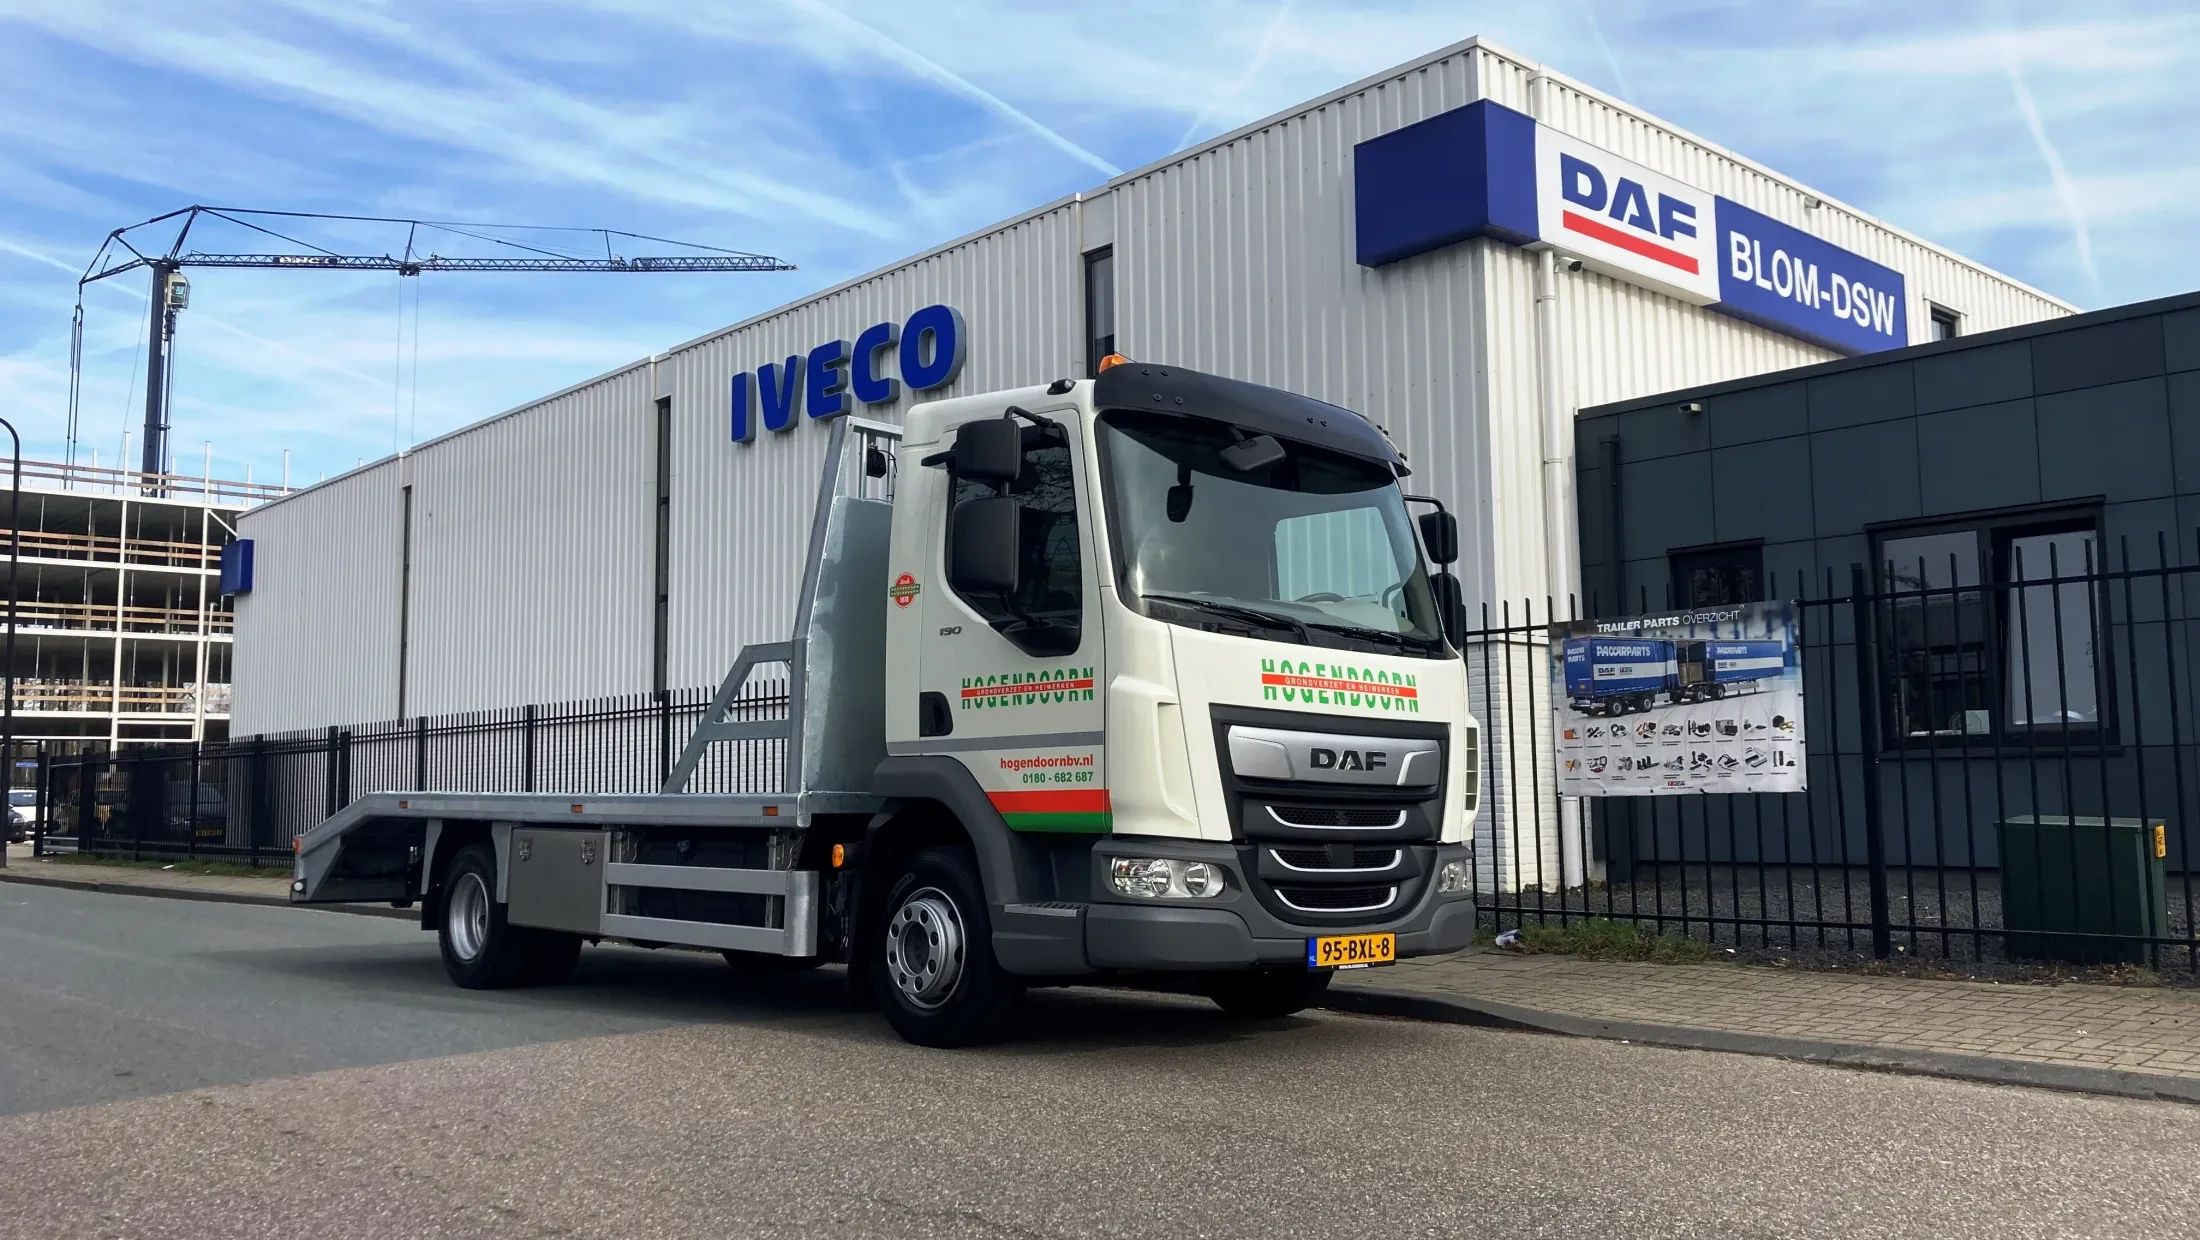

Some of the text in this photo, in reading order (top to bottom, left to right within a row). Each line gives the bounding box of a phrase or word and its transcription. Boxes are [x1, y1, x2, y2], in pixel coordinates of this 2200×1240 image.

[1560, 152, 1697, 241] DAF
[1729, 230, 1895, 336] BLOM-DSW
[731, 304, 967, 444] IVECO
[939, 625, 963, 636] 190
[1597, 610, 1741, 633] TRAILER PARTS OVERZICHT
[961, 666, 1094, 710] HOGENDOORN
[976, 682, 1075, 696] GRONDVERZET EN HEIWERKEN
[1261, 658, 1419, 713] HOGENDOORN
[1285, 676, 1400, 695] GRONDVERZET EN HEIWERKEN
[1000, 753, 1094, 772] hogendoornbv.nl
[1310, 747, 1387, 772] DAF
[1022, 773, 1046, 784] 0180
[1054, 772, 1073, 783] 682
[1075, 771, 1093, 782] 687
[1322, 937, 1390, 962] 95-BXL-8
